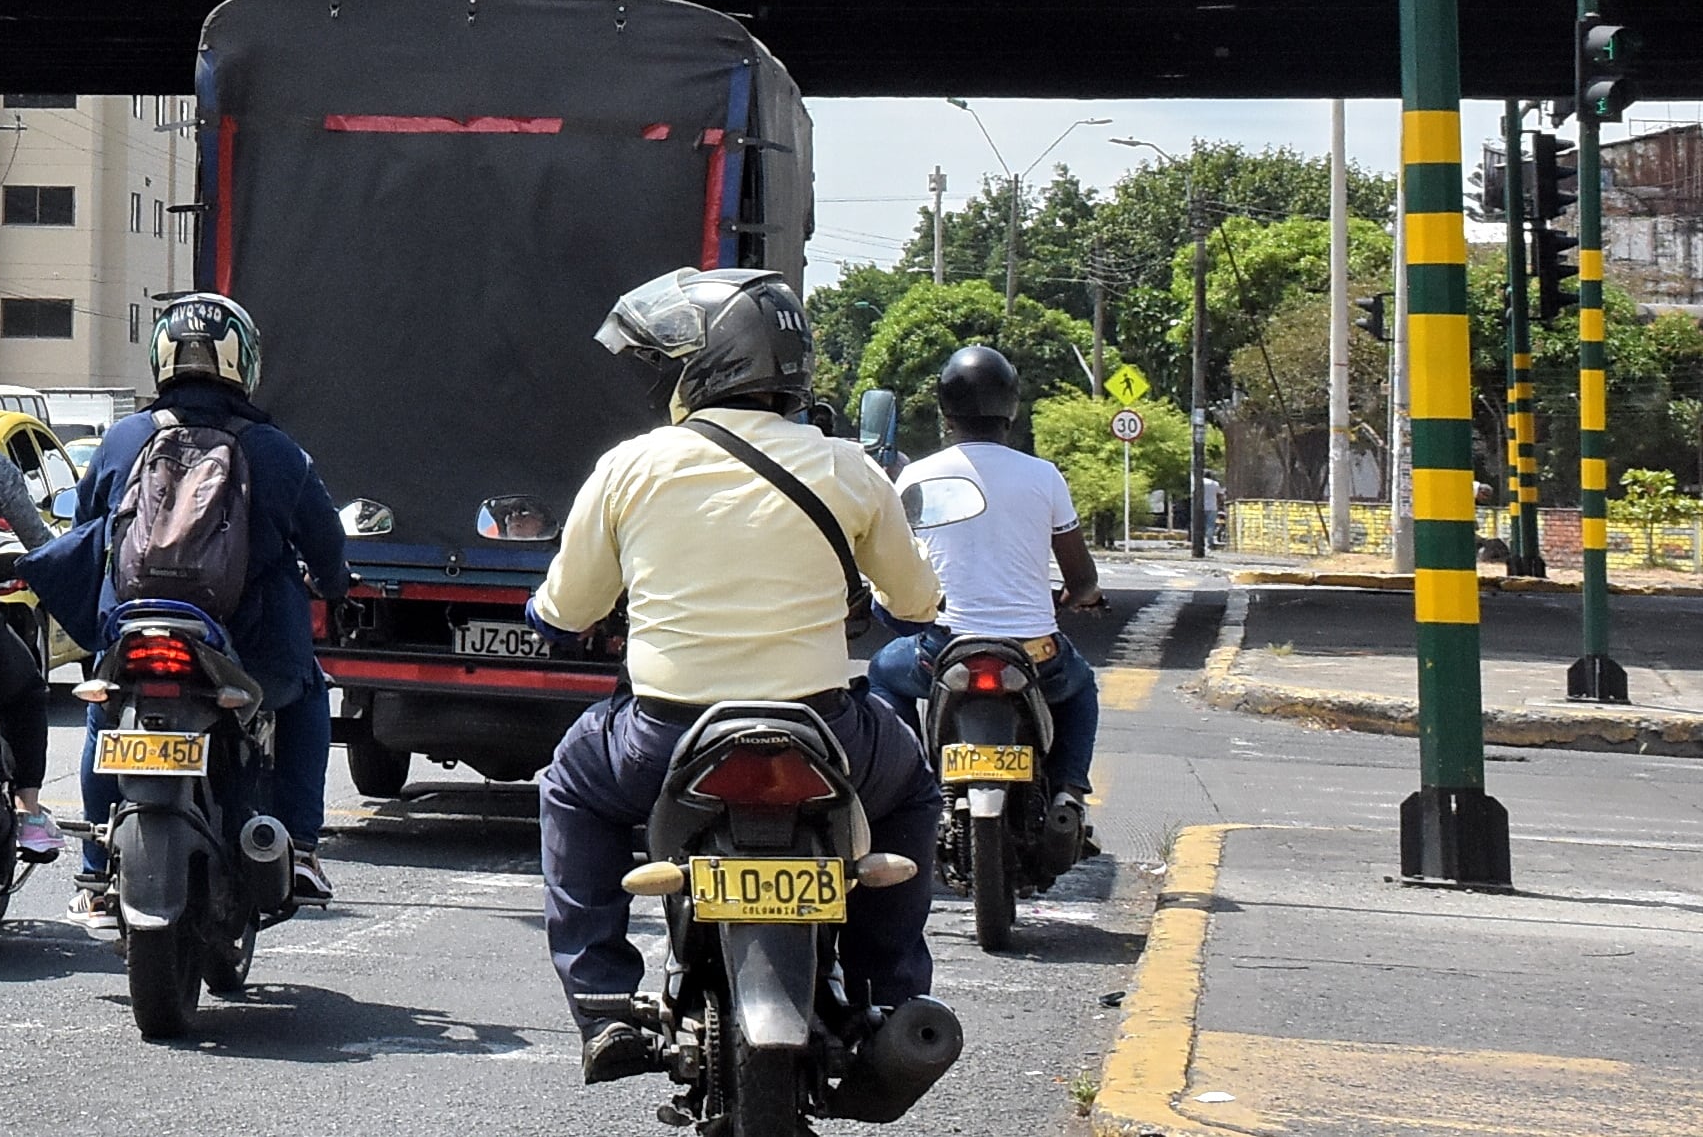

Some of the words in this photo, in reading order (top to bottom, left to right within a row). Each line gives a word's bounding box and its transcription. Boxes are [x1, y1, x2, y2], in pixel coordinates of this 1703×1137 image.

[1117, 417, 1138, 433] 30
[739, 736, 790, 745] HONDA
[742, 906, 796, 915] COLOMBIA
